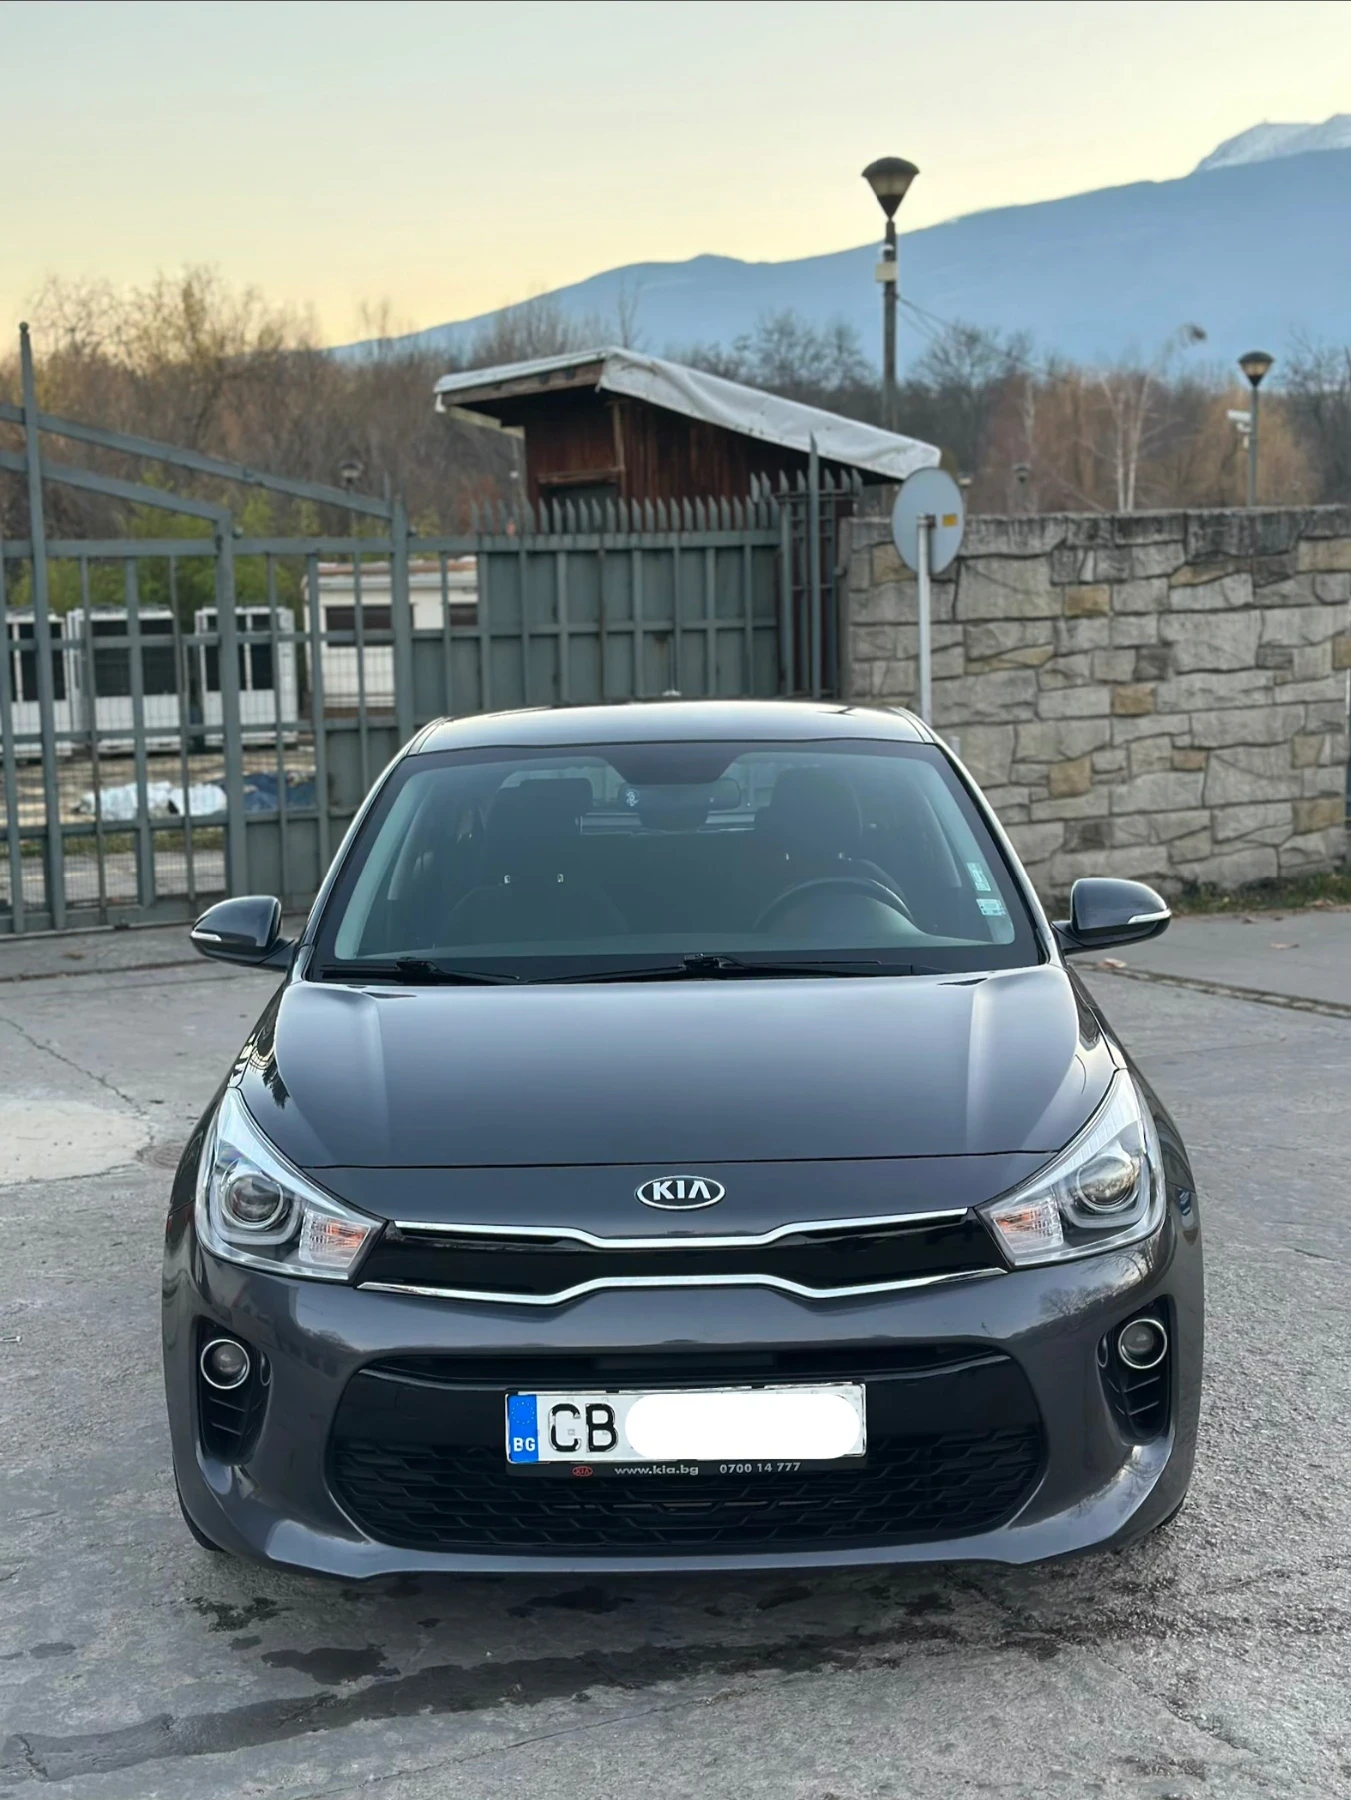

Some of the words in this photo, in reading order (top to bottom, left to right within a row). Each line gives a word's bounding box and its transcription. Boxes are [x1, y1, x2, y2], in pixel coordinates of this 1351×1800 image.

[652, 1179, 712, 1201] KIA
[549, 1403, 618, 1453] CB
[513, 1437, 536, 1452] BG
[614, 1465, 699, 1476] www.kia.bg
[720, 1463, 752, 1474] 0700
[757, 1463, 773, 1473] 14
[777, 1462, 801, 1472] 777
